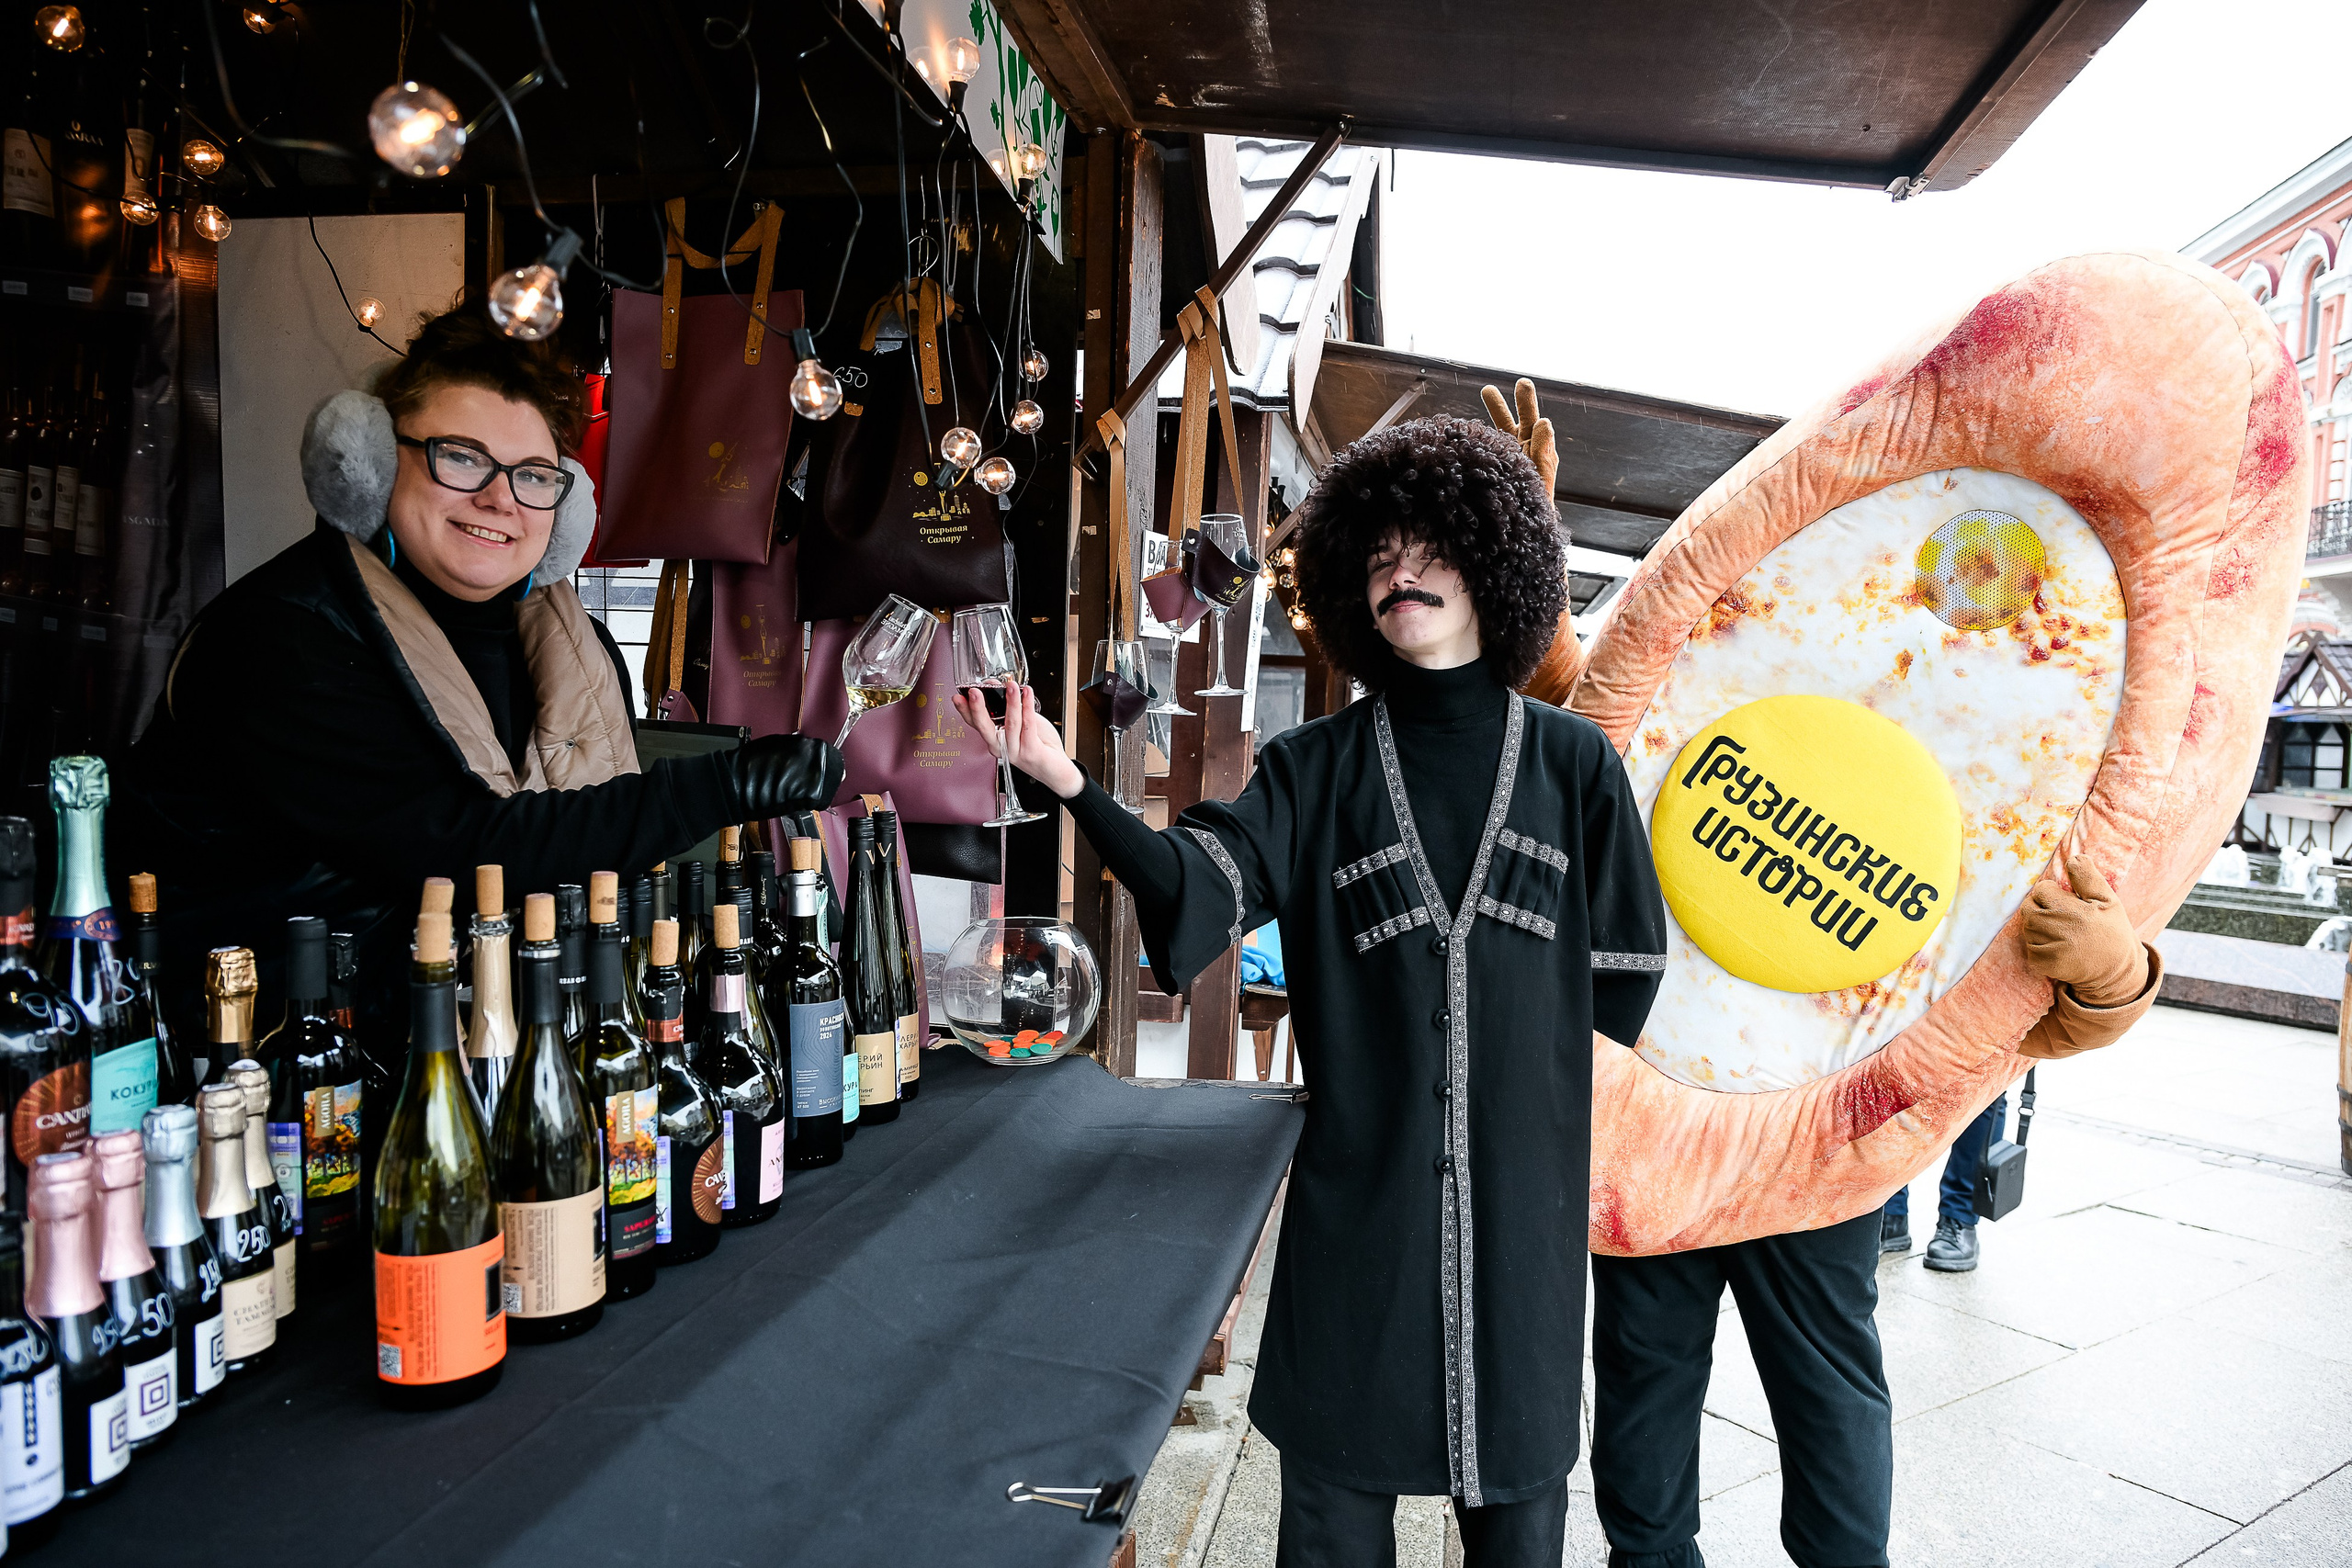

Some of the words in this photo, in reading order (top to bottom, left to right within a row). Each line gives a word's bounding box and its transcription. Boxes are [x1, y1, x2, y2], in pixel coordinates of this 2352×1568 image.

[919, 525, 968, 536] Открывая
[927, 535, 962, 544] Самару
[912, 749, 961, 760] Открывая
[919, 759, 954, 769] Самару
[1691, 807, 1879, 952] ИСТОРИИ
[857, 1053, 883, 1063] ЕРИЙ
[321, 1091, 332, 1130] AGORA
[621, 1096, 632, 1136] AGORA
[237, 1224, 272, 1263] 250
